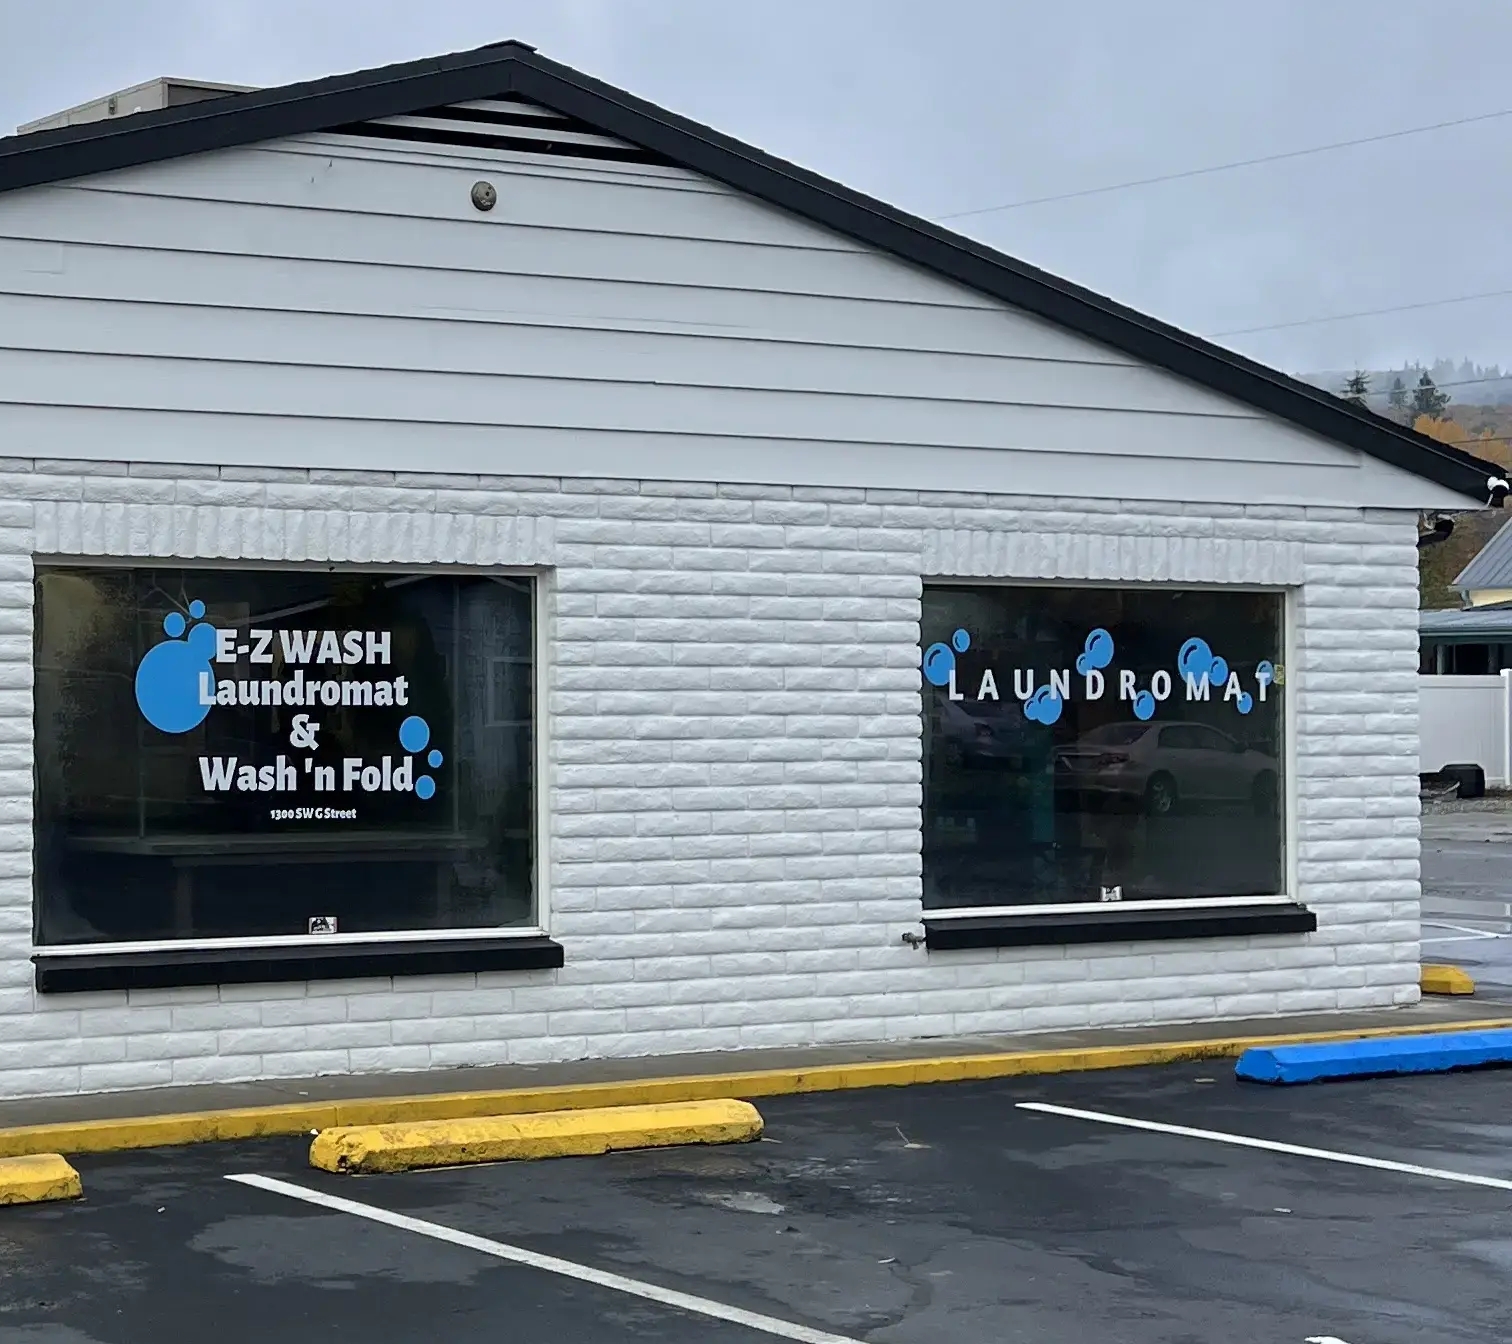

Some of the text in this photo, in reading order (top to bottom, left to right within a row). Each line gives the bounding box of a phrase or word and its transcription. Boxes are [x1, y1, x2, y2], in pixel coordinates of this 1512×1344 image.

[215, 628, 392, 665] E-Z WASH
[198, 669, 409, 707] Laundromat
[948, 668, 1271, 703] LAUNDROMAT
[289, 713, 321, 751] &
[198, 754, 414, 792] Wash 'n Fold
[270, 807, 357, 821] 1300 SW G Street
